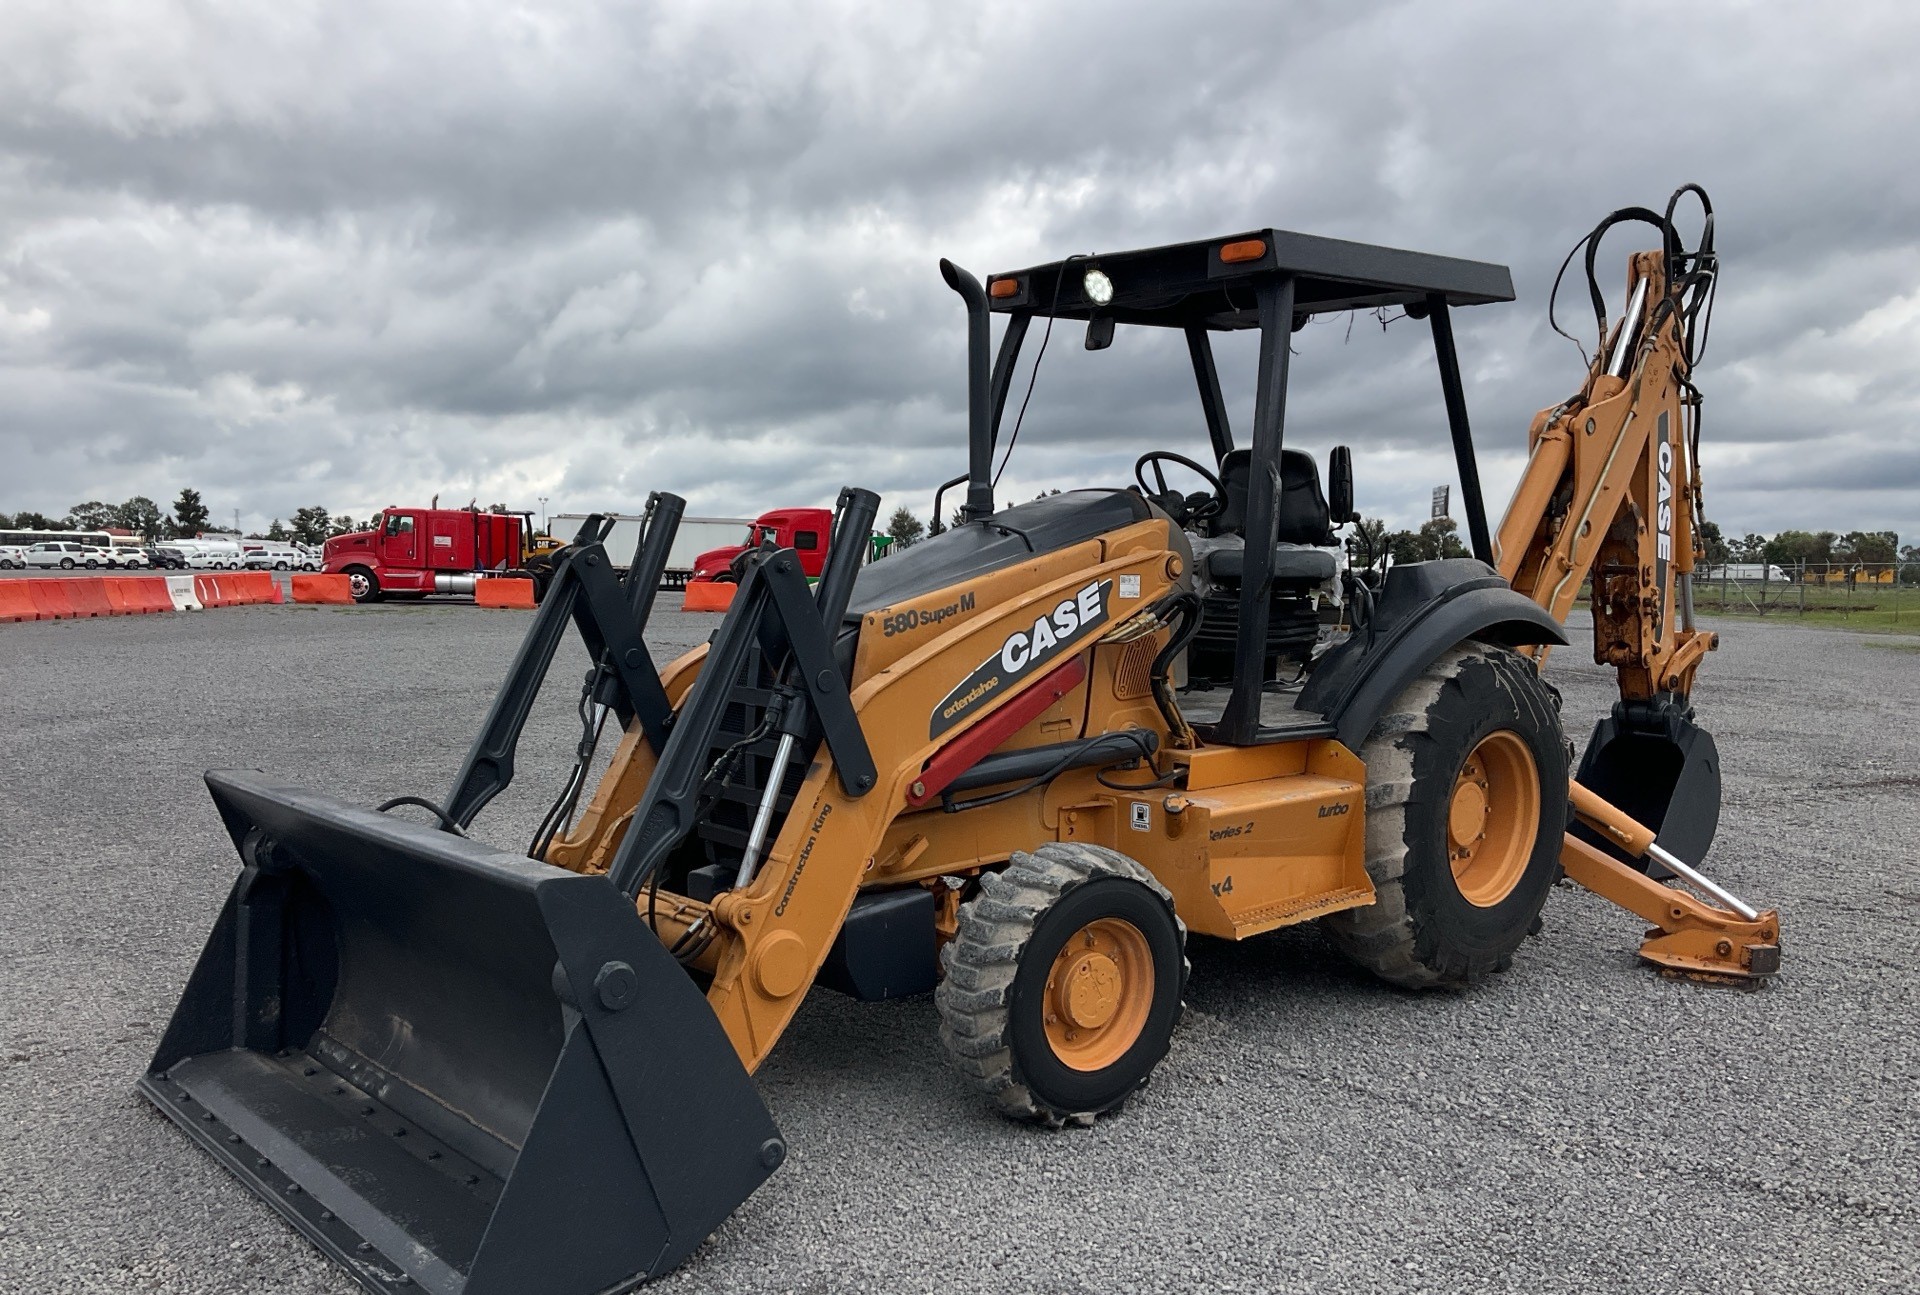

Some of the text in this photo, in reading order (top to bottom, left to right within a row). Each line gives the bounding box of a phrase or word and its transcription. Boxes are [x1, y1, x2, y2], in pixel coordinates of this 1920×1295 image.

[1657, 441, 1672, 561] CASE
[537, 540, 550, 549] CAT
[883, 609, 919, 637] 580
[960, 591, 975, 613] M
[1001, 581, 1102, 673] CASE
[943, 676, 999, 719] extendahoe
[1244, 821, 1255, 835] 2
[1317, 801, 1350, 819] turbo
[775, 803, 833, 917] Construction King
